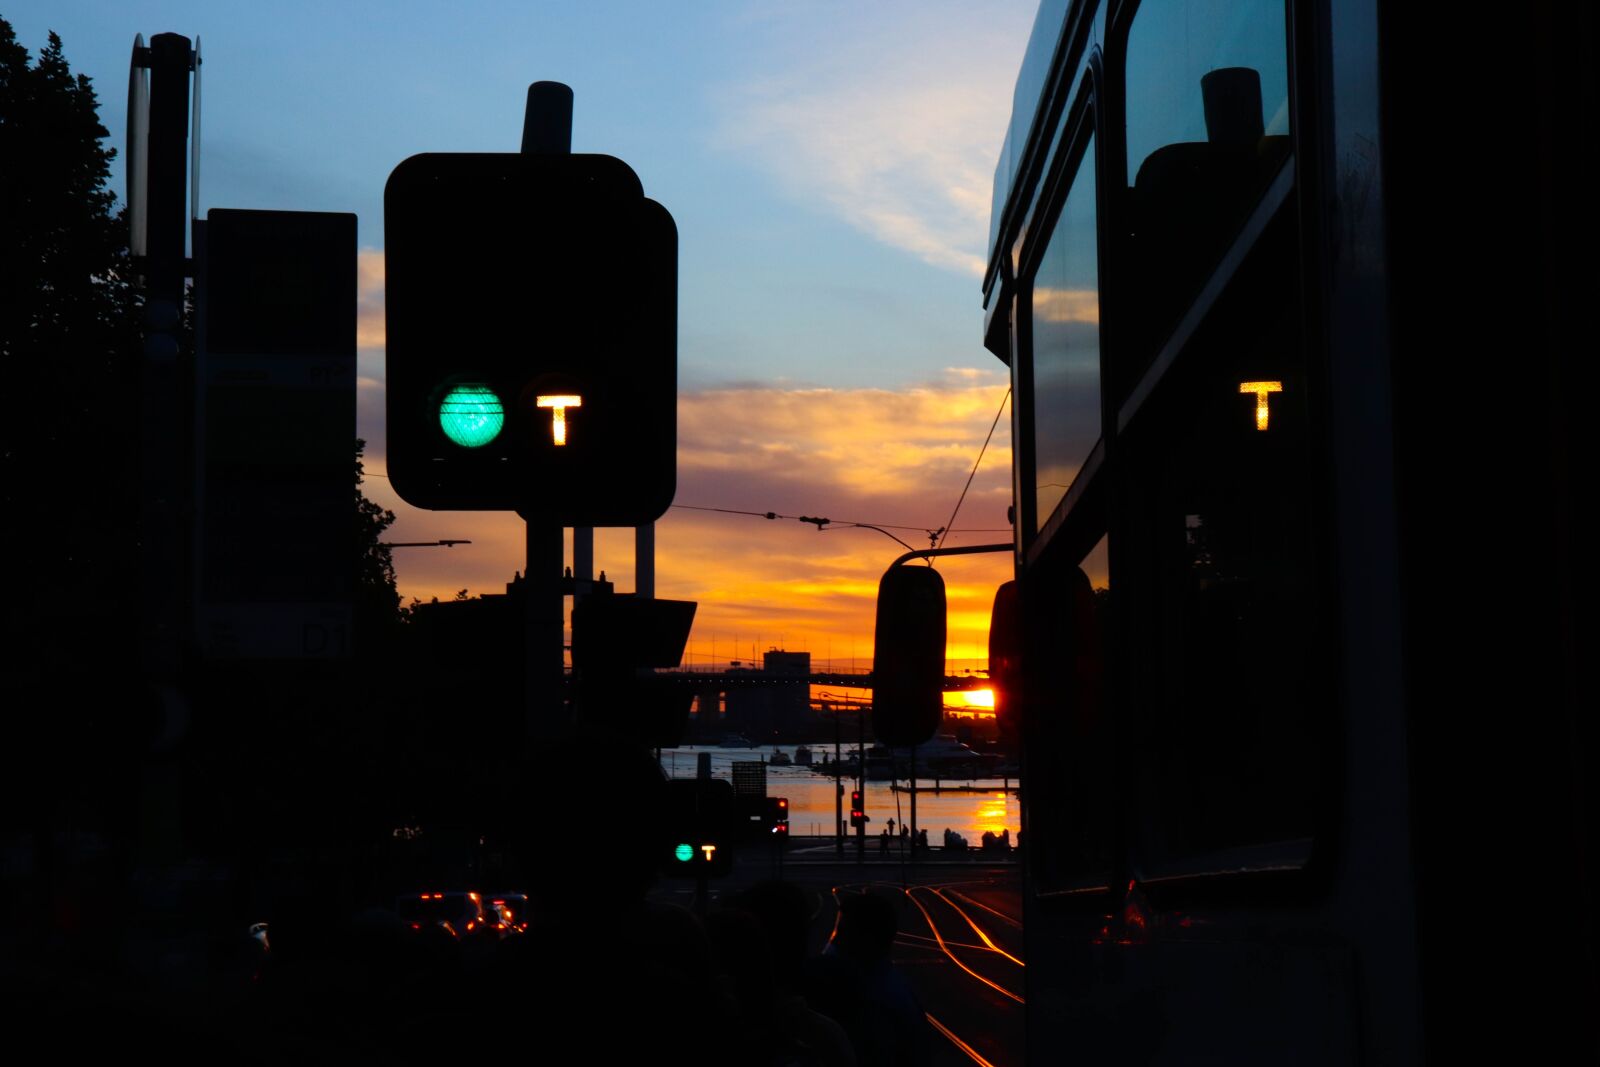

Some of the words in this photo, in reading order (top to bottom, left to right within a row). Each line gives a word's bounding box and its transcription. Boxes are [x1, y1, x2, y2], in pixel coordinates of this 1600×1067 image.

[536, 394, 583, 447] T
[303, 623, 346, 654] D1
[701, 845, 717, 861] T
